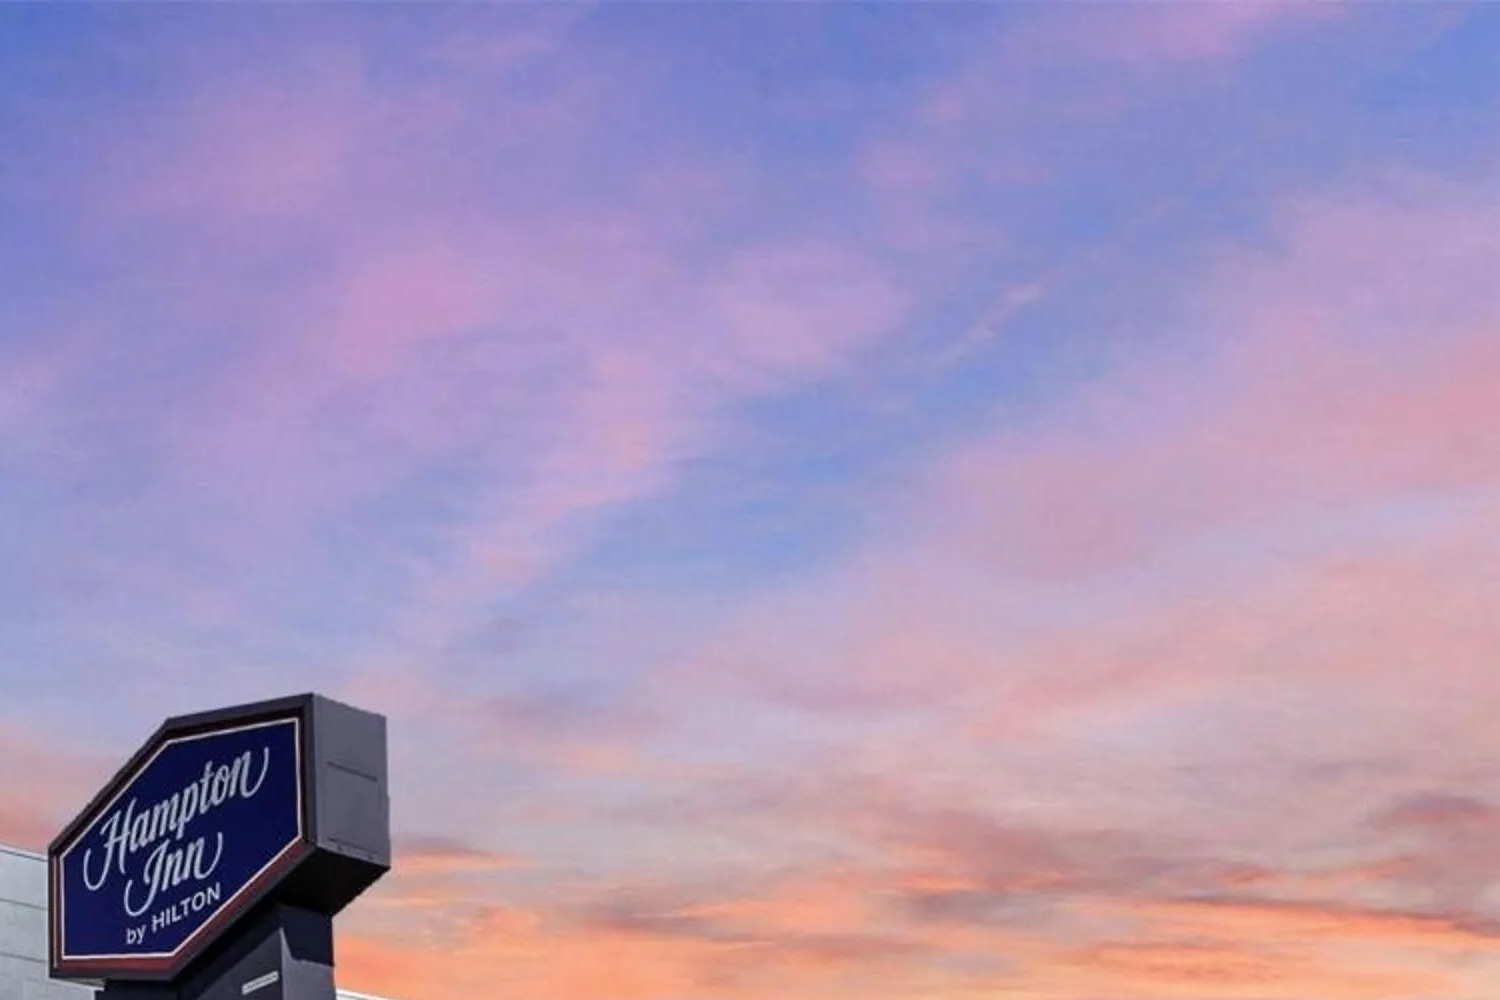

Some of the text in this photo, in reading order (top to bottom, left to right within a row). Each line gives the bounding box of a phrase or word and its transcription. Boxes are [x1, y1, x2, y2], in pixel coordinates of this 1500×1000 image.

[84, 747, 269, 890] Hampton
[124, 832, 223, 916] Inn
[127, 882, 221, 945] by HILTON
